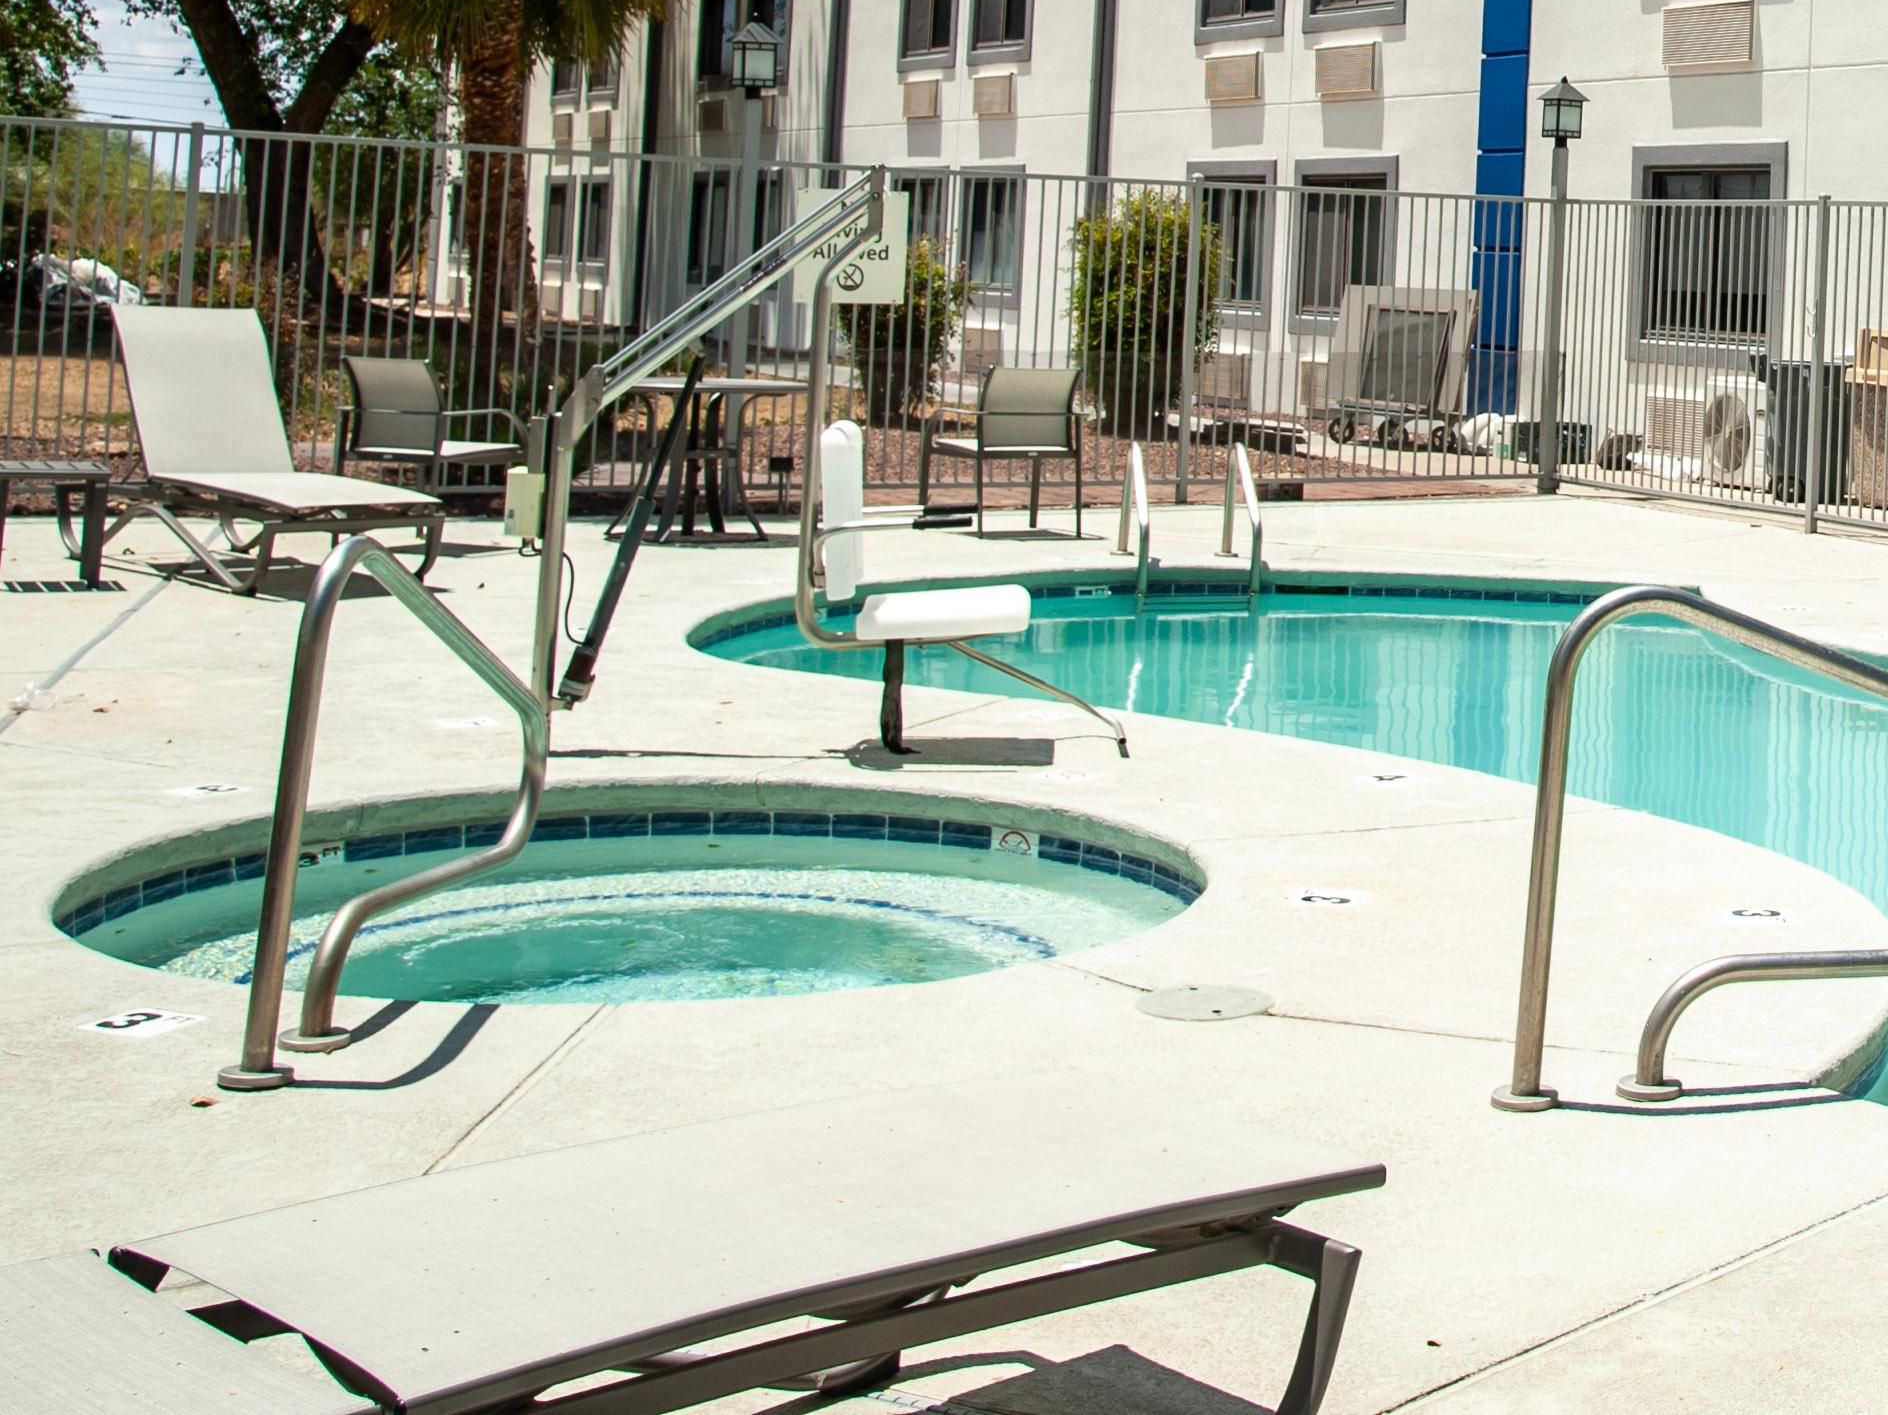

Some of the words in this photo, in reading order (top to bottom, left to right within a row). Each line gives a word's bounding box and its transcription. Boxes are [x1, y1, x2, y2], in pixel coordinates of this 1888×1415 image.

[812, 243, 890, 261] Alled
[322, 846, 340, 858] FT
[95, 1012, 163, 1029] 3
